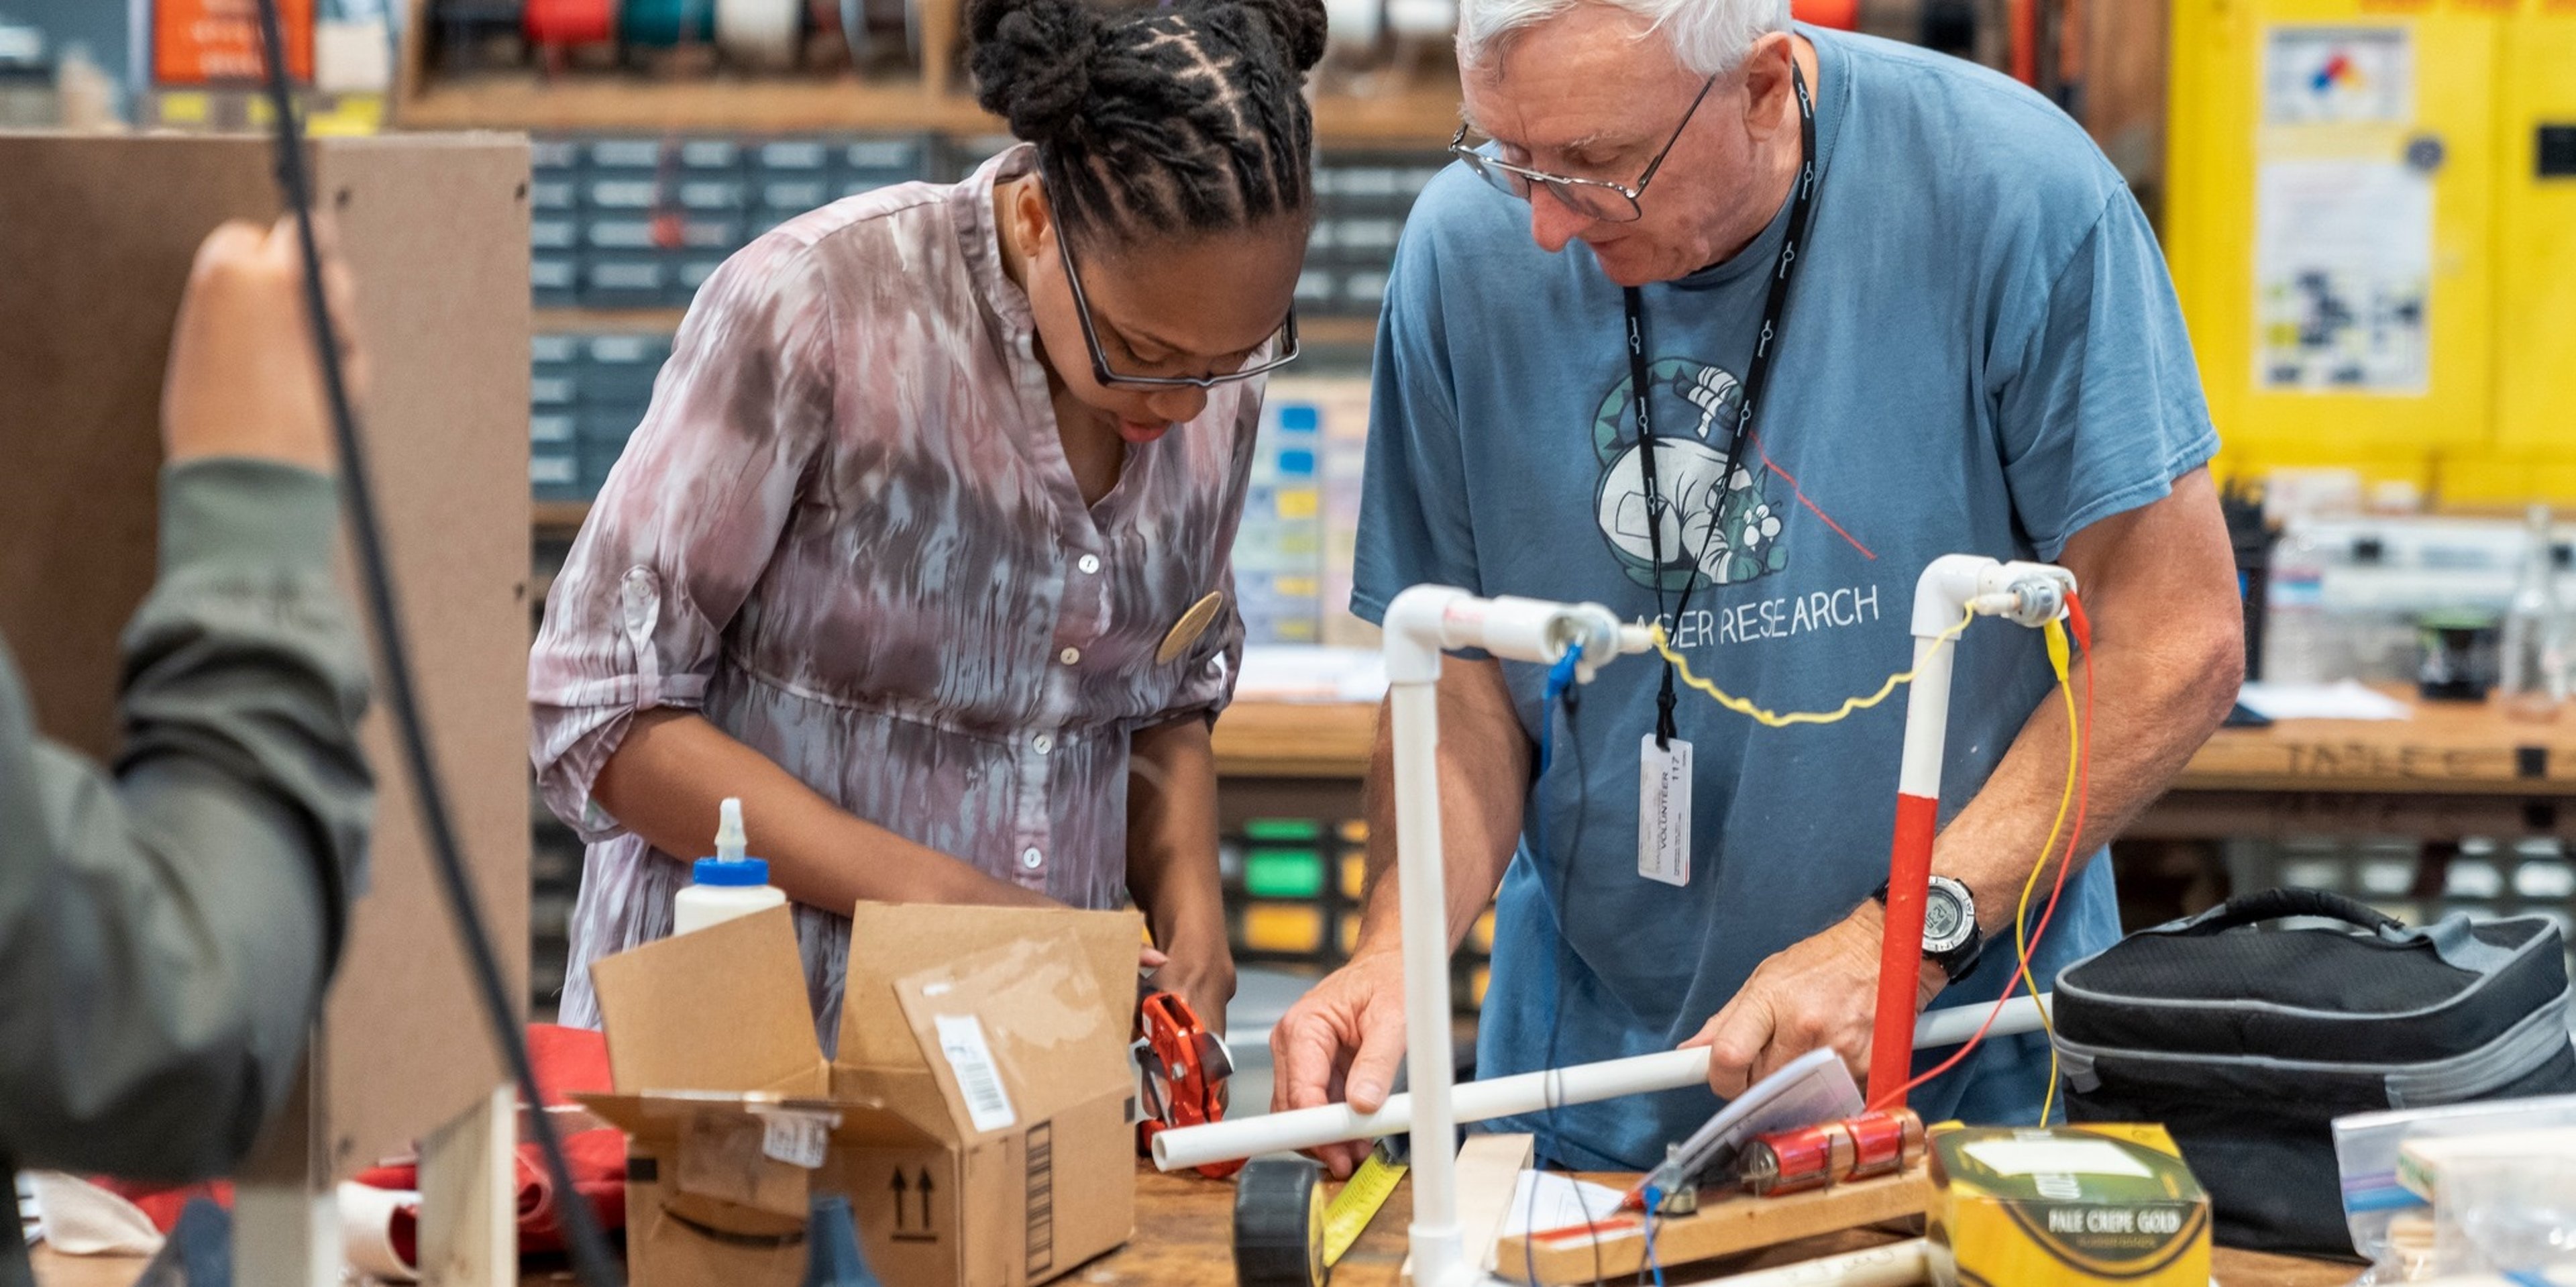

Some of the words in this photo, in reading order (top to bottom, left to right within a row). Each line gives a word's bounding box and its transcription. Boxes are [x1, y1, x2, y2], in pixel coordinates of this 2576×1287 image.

[1720, 584, 1880, 645] RESEARCH
[1672, 756, 1680, 781] 117
[1660, 771, 1669, 850] VOLUNTEER
[2048, 1209, 2084, 1233] PALE
[2086, 1209, 2135, 1233] CREPE
[2137, 1209, 2181, 1233] GOLD
